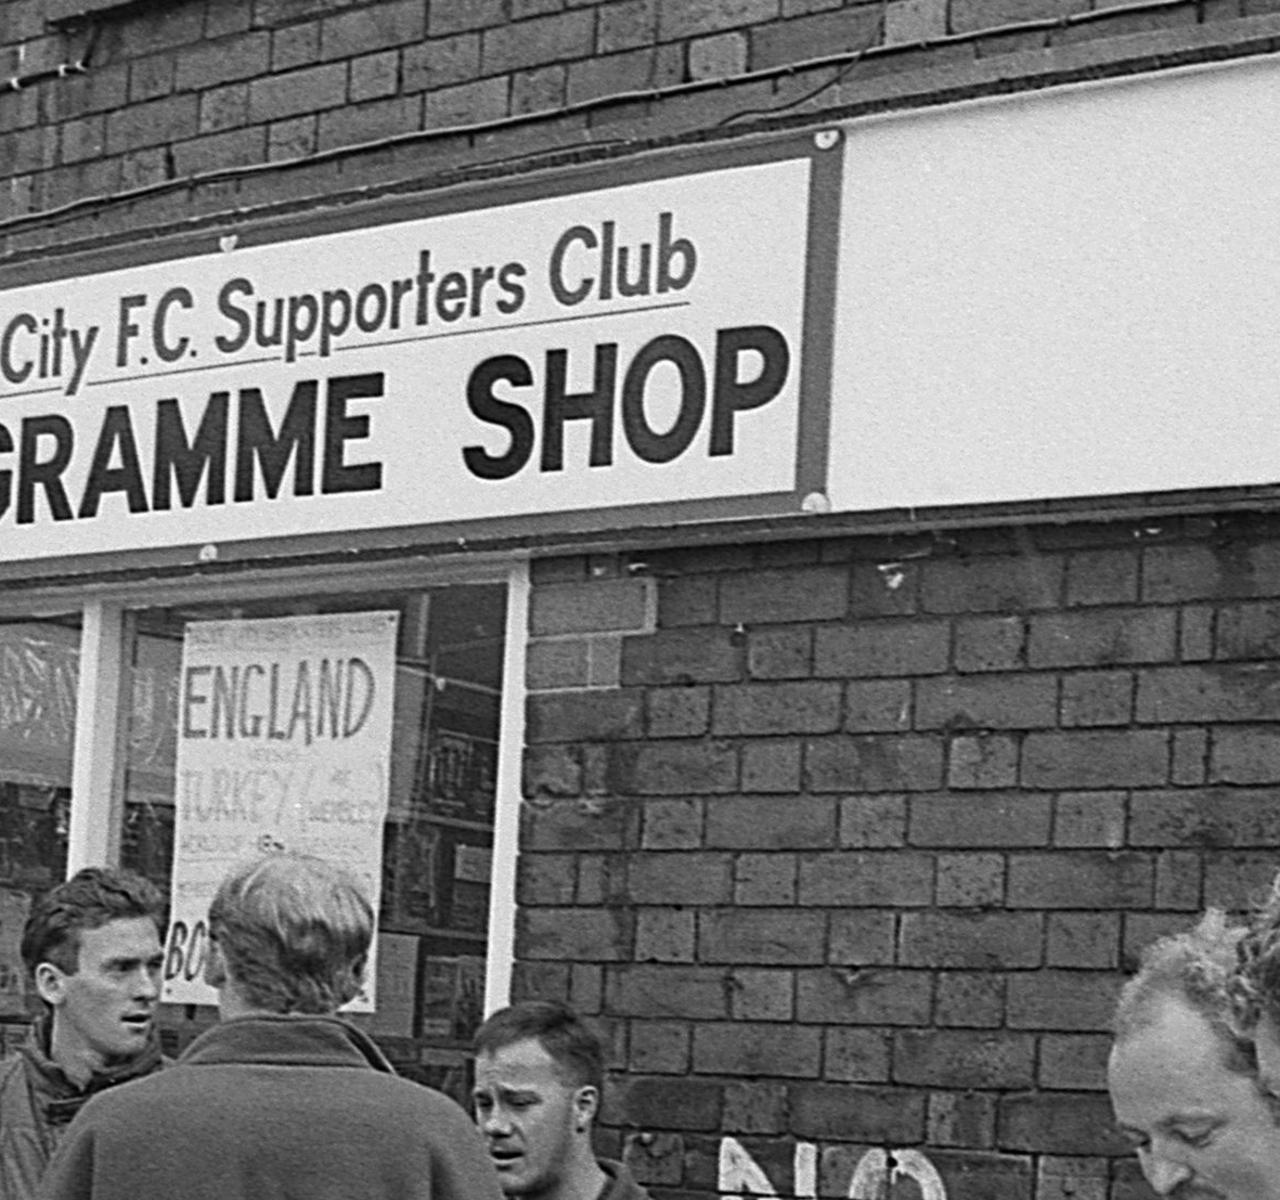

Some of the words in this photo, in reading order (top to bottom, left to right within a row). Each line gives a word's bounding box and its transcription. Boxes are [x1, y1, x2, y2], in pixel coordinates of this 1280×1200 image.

[0, 308, 99, 396] City
[116, 287, 198, 368] F.C.
[214, 250, 527, 362] Supporters
[549, 212, 697, 306] Club
[462, 324, 791, 481] SHOP
[182, 656, 376, 746] ENGLAND
[164, 920, 207, 982] BO
